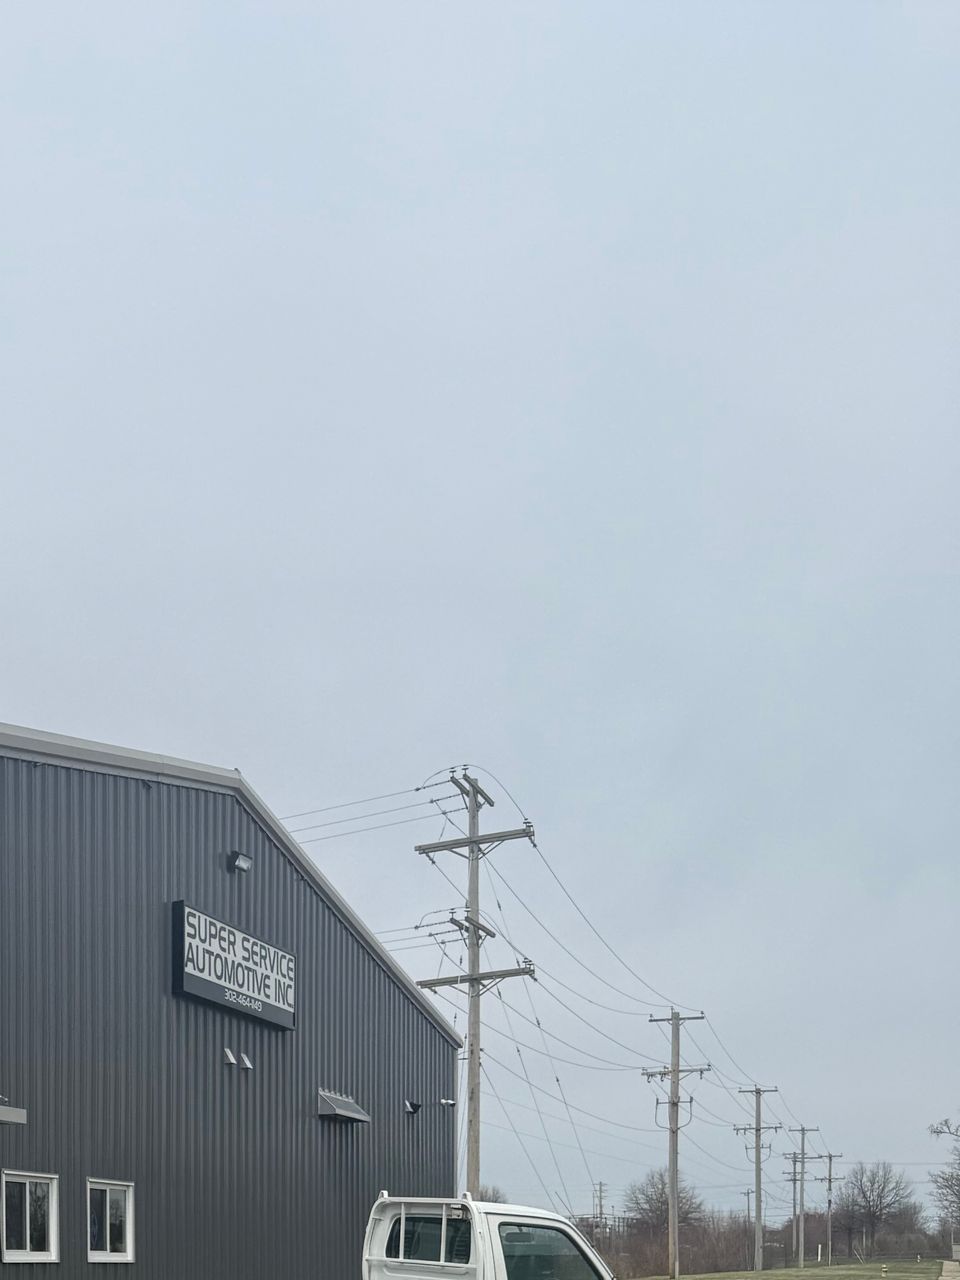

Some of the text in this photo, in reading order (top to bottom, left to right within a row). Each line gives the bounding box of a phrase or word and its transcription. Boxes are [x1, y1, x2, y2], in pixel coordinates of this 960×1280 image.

[185, 942, 271, 1000] AUTOMOTIVE
[186, 911, 294, 982] SUPER SERVICE
